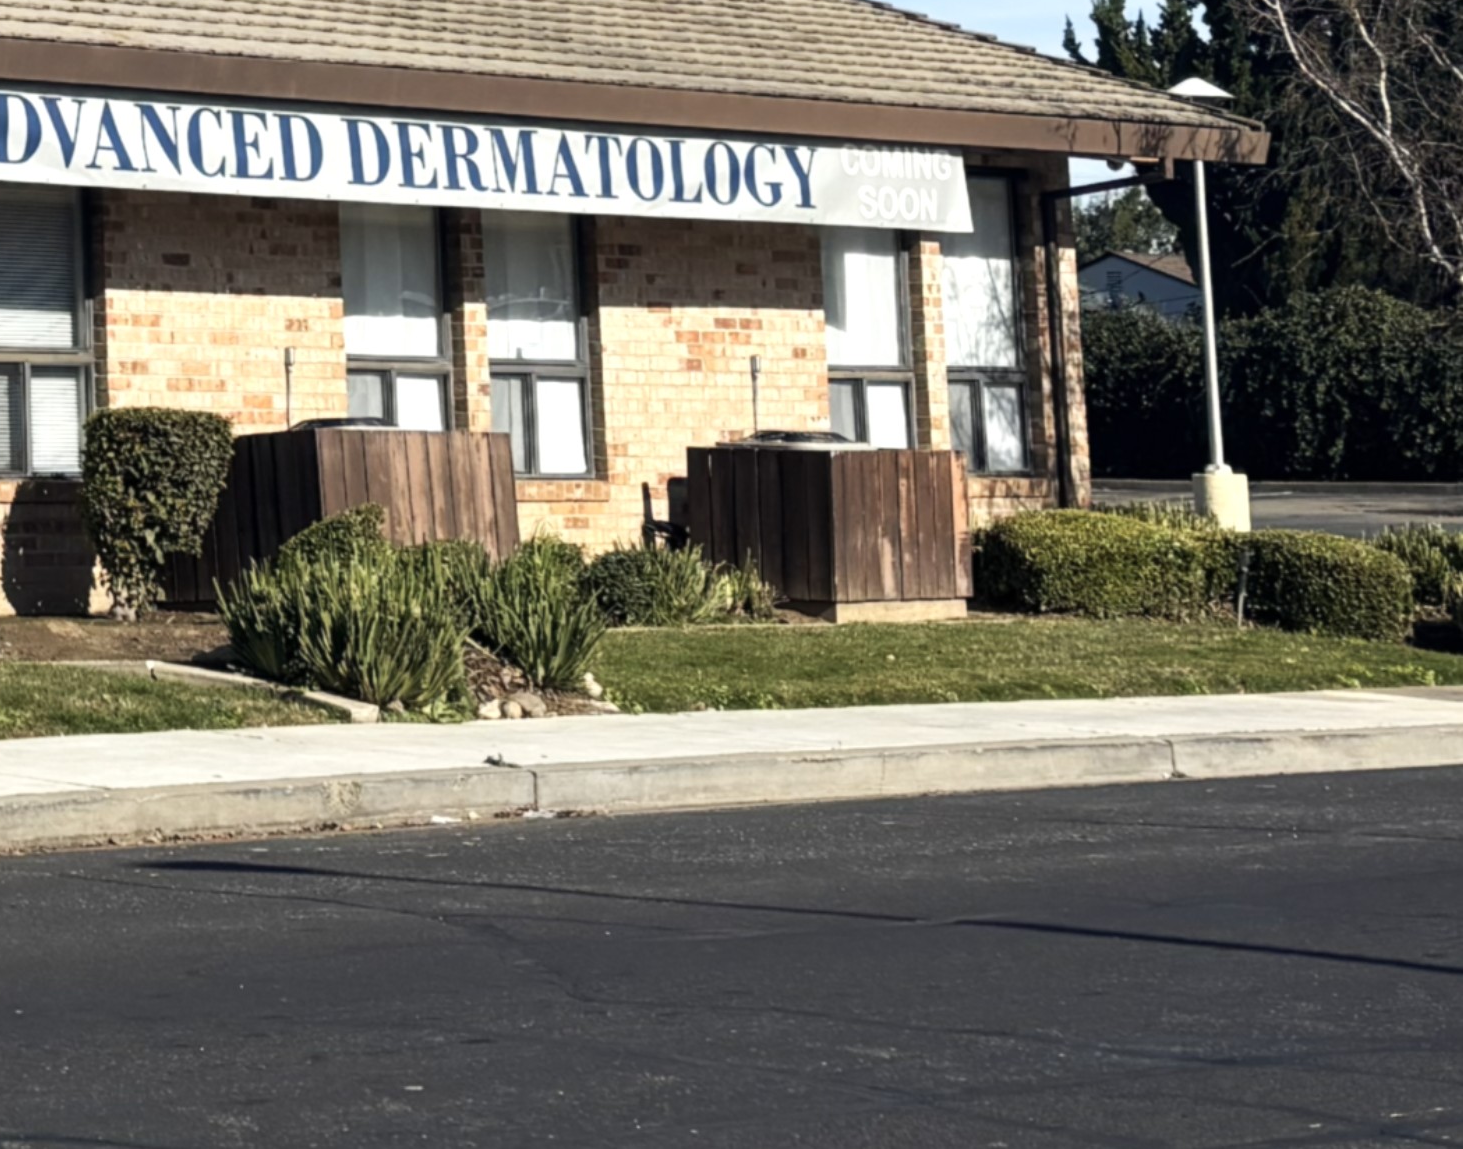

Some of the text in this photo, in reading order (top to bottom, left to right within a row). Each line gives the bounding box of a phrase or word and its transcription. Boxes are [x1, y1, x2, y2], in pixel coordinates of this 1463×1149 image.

[340, 117, 819, 209] DERMATOLOGY
[840, 143, 952, 181] COMING
[858, 184, 938, 222] SOON
